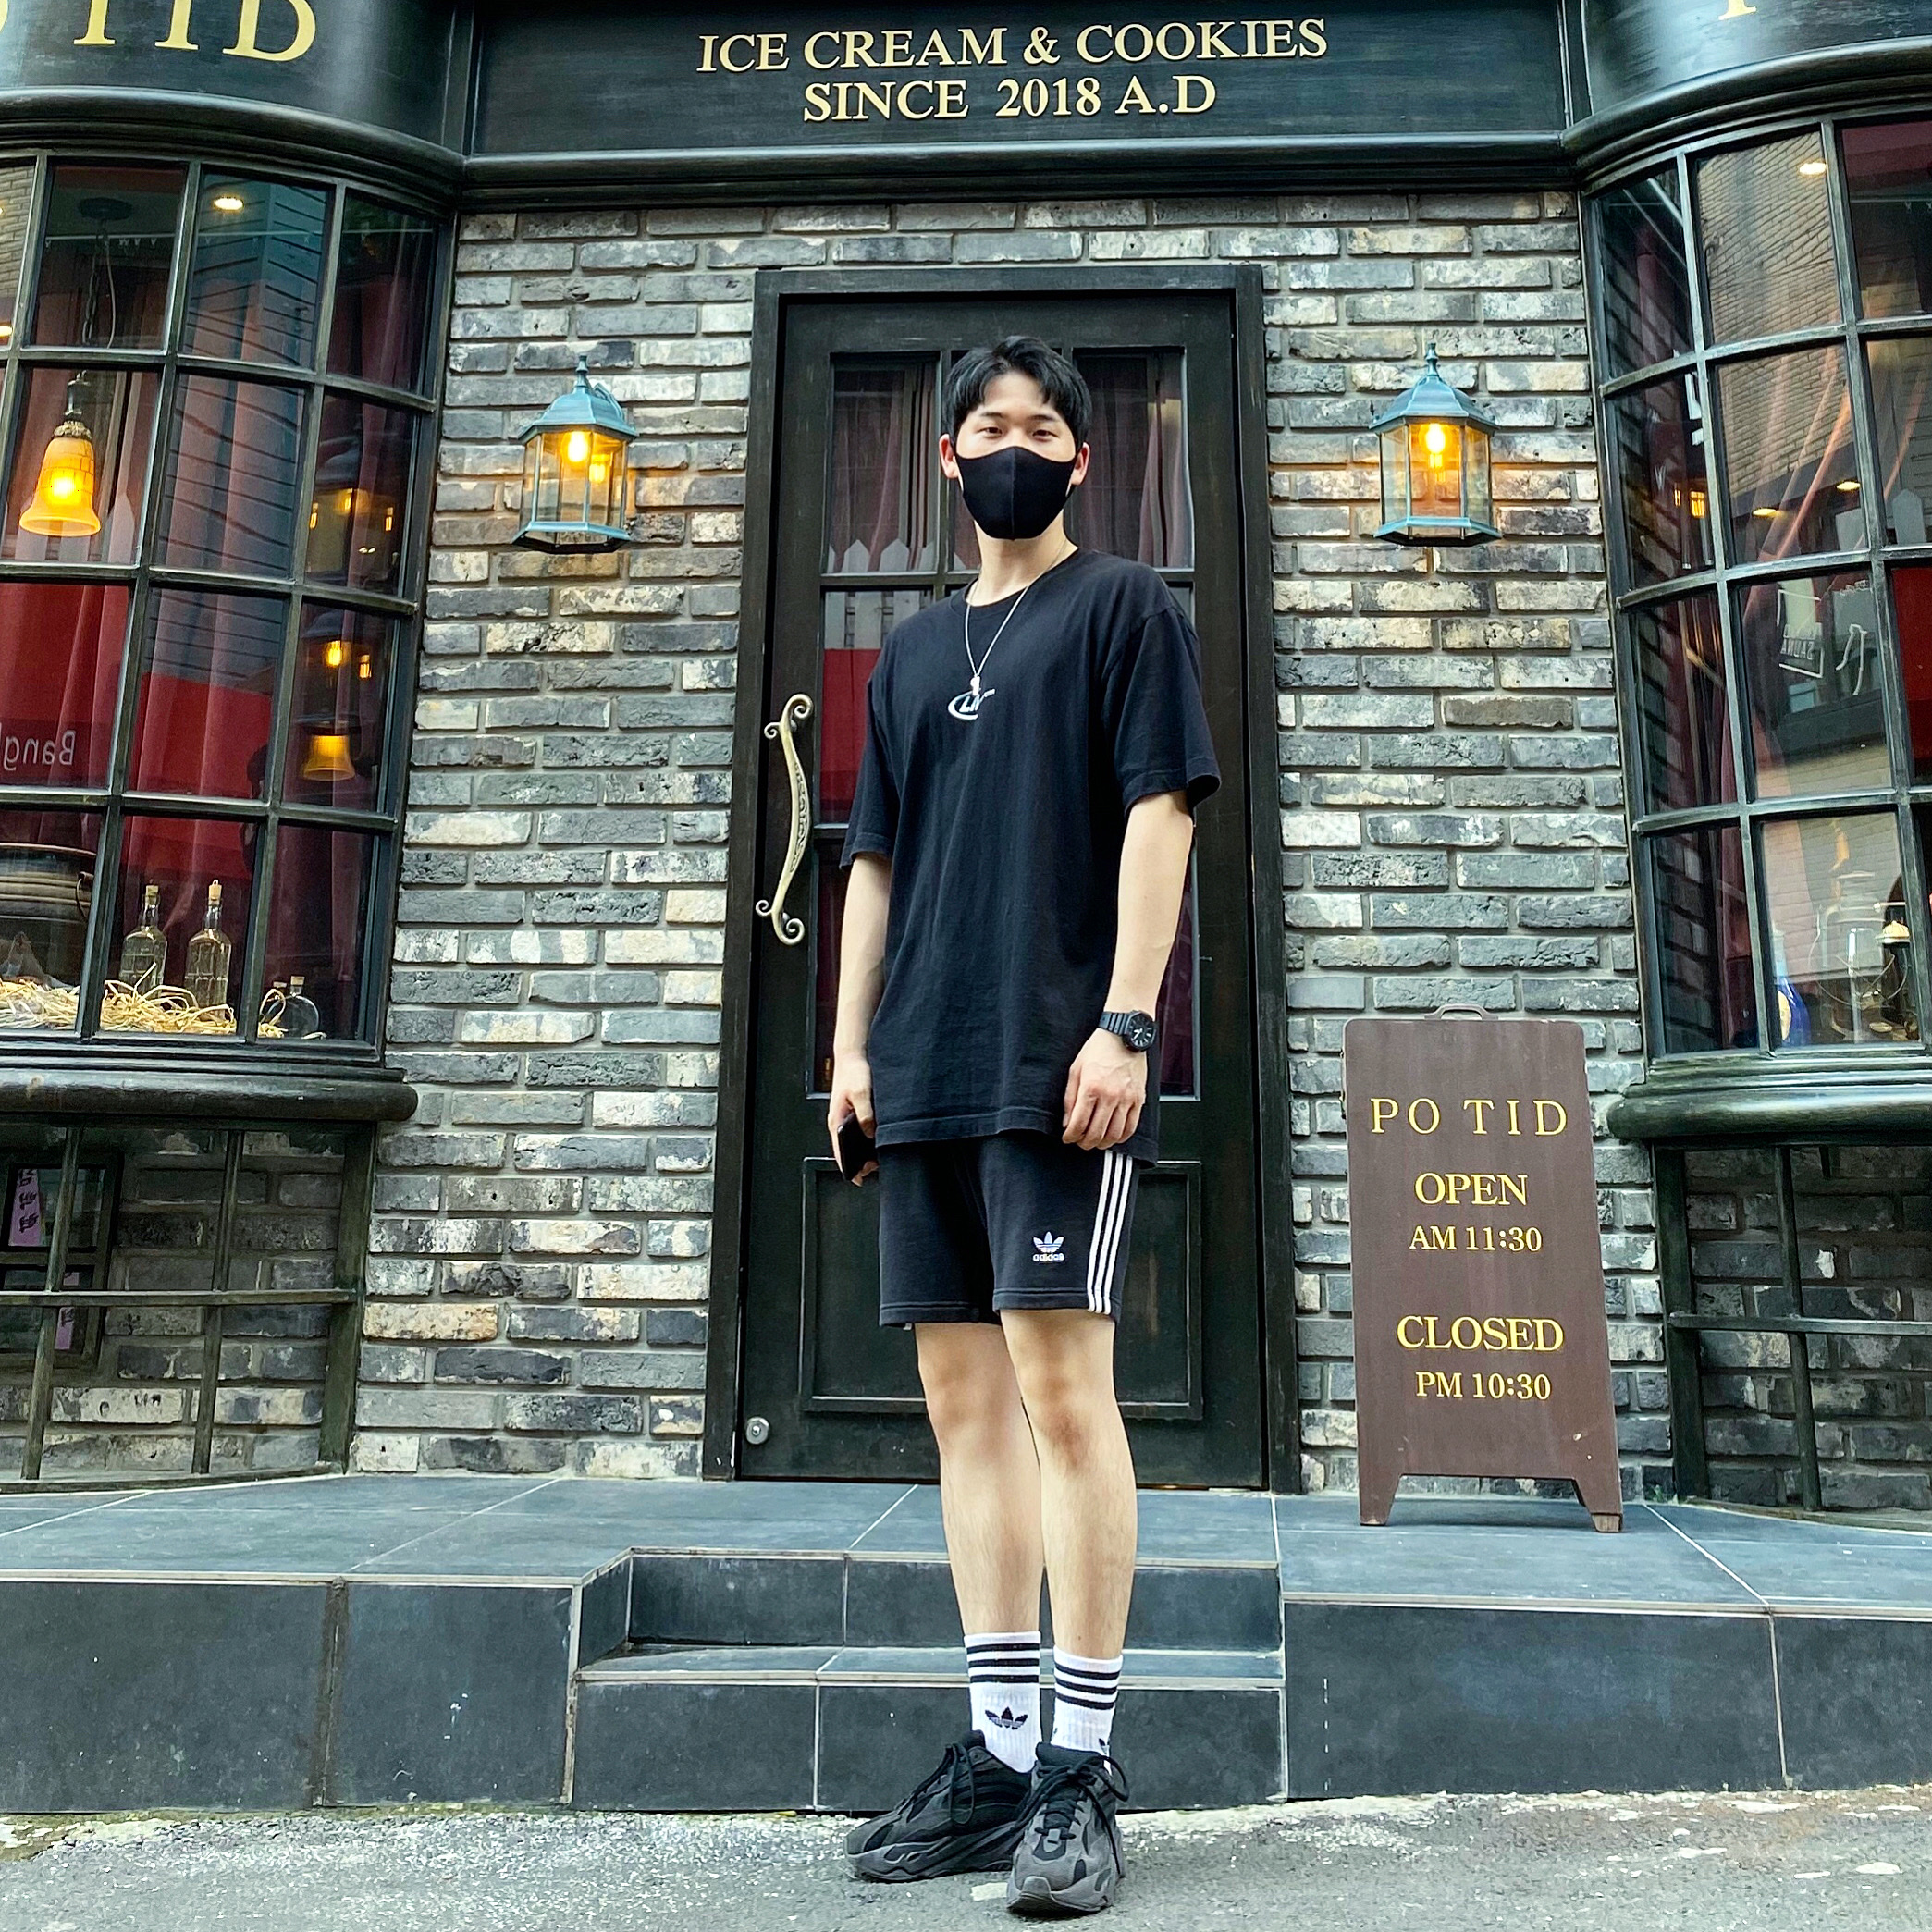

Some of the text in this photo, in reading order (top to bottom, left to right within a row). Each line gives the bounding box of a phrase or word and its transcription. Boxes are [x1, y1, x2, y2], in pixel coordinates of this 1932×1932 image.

[695, 18, 1328, 73] ICE CREAM & COOKIES
[803, 75, 1217, 122] SINCE 2018 A.D
[1463, 1099, 1568, 1137] TID
[1414, 1172, 1528, 1206] OPEN
[1409, 1225, 1542, 1252] AM 11:30
[1397, 1315, 1565, 1353] CLOSED
[1415, 1371, 1552, 1400] PM 10:30
